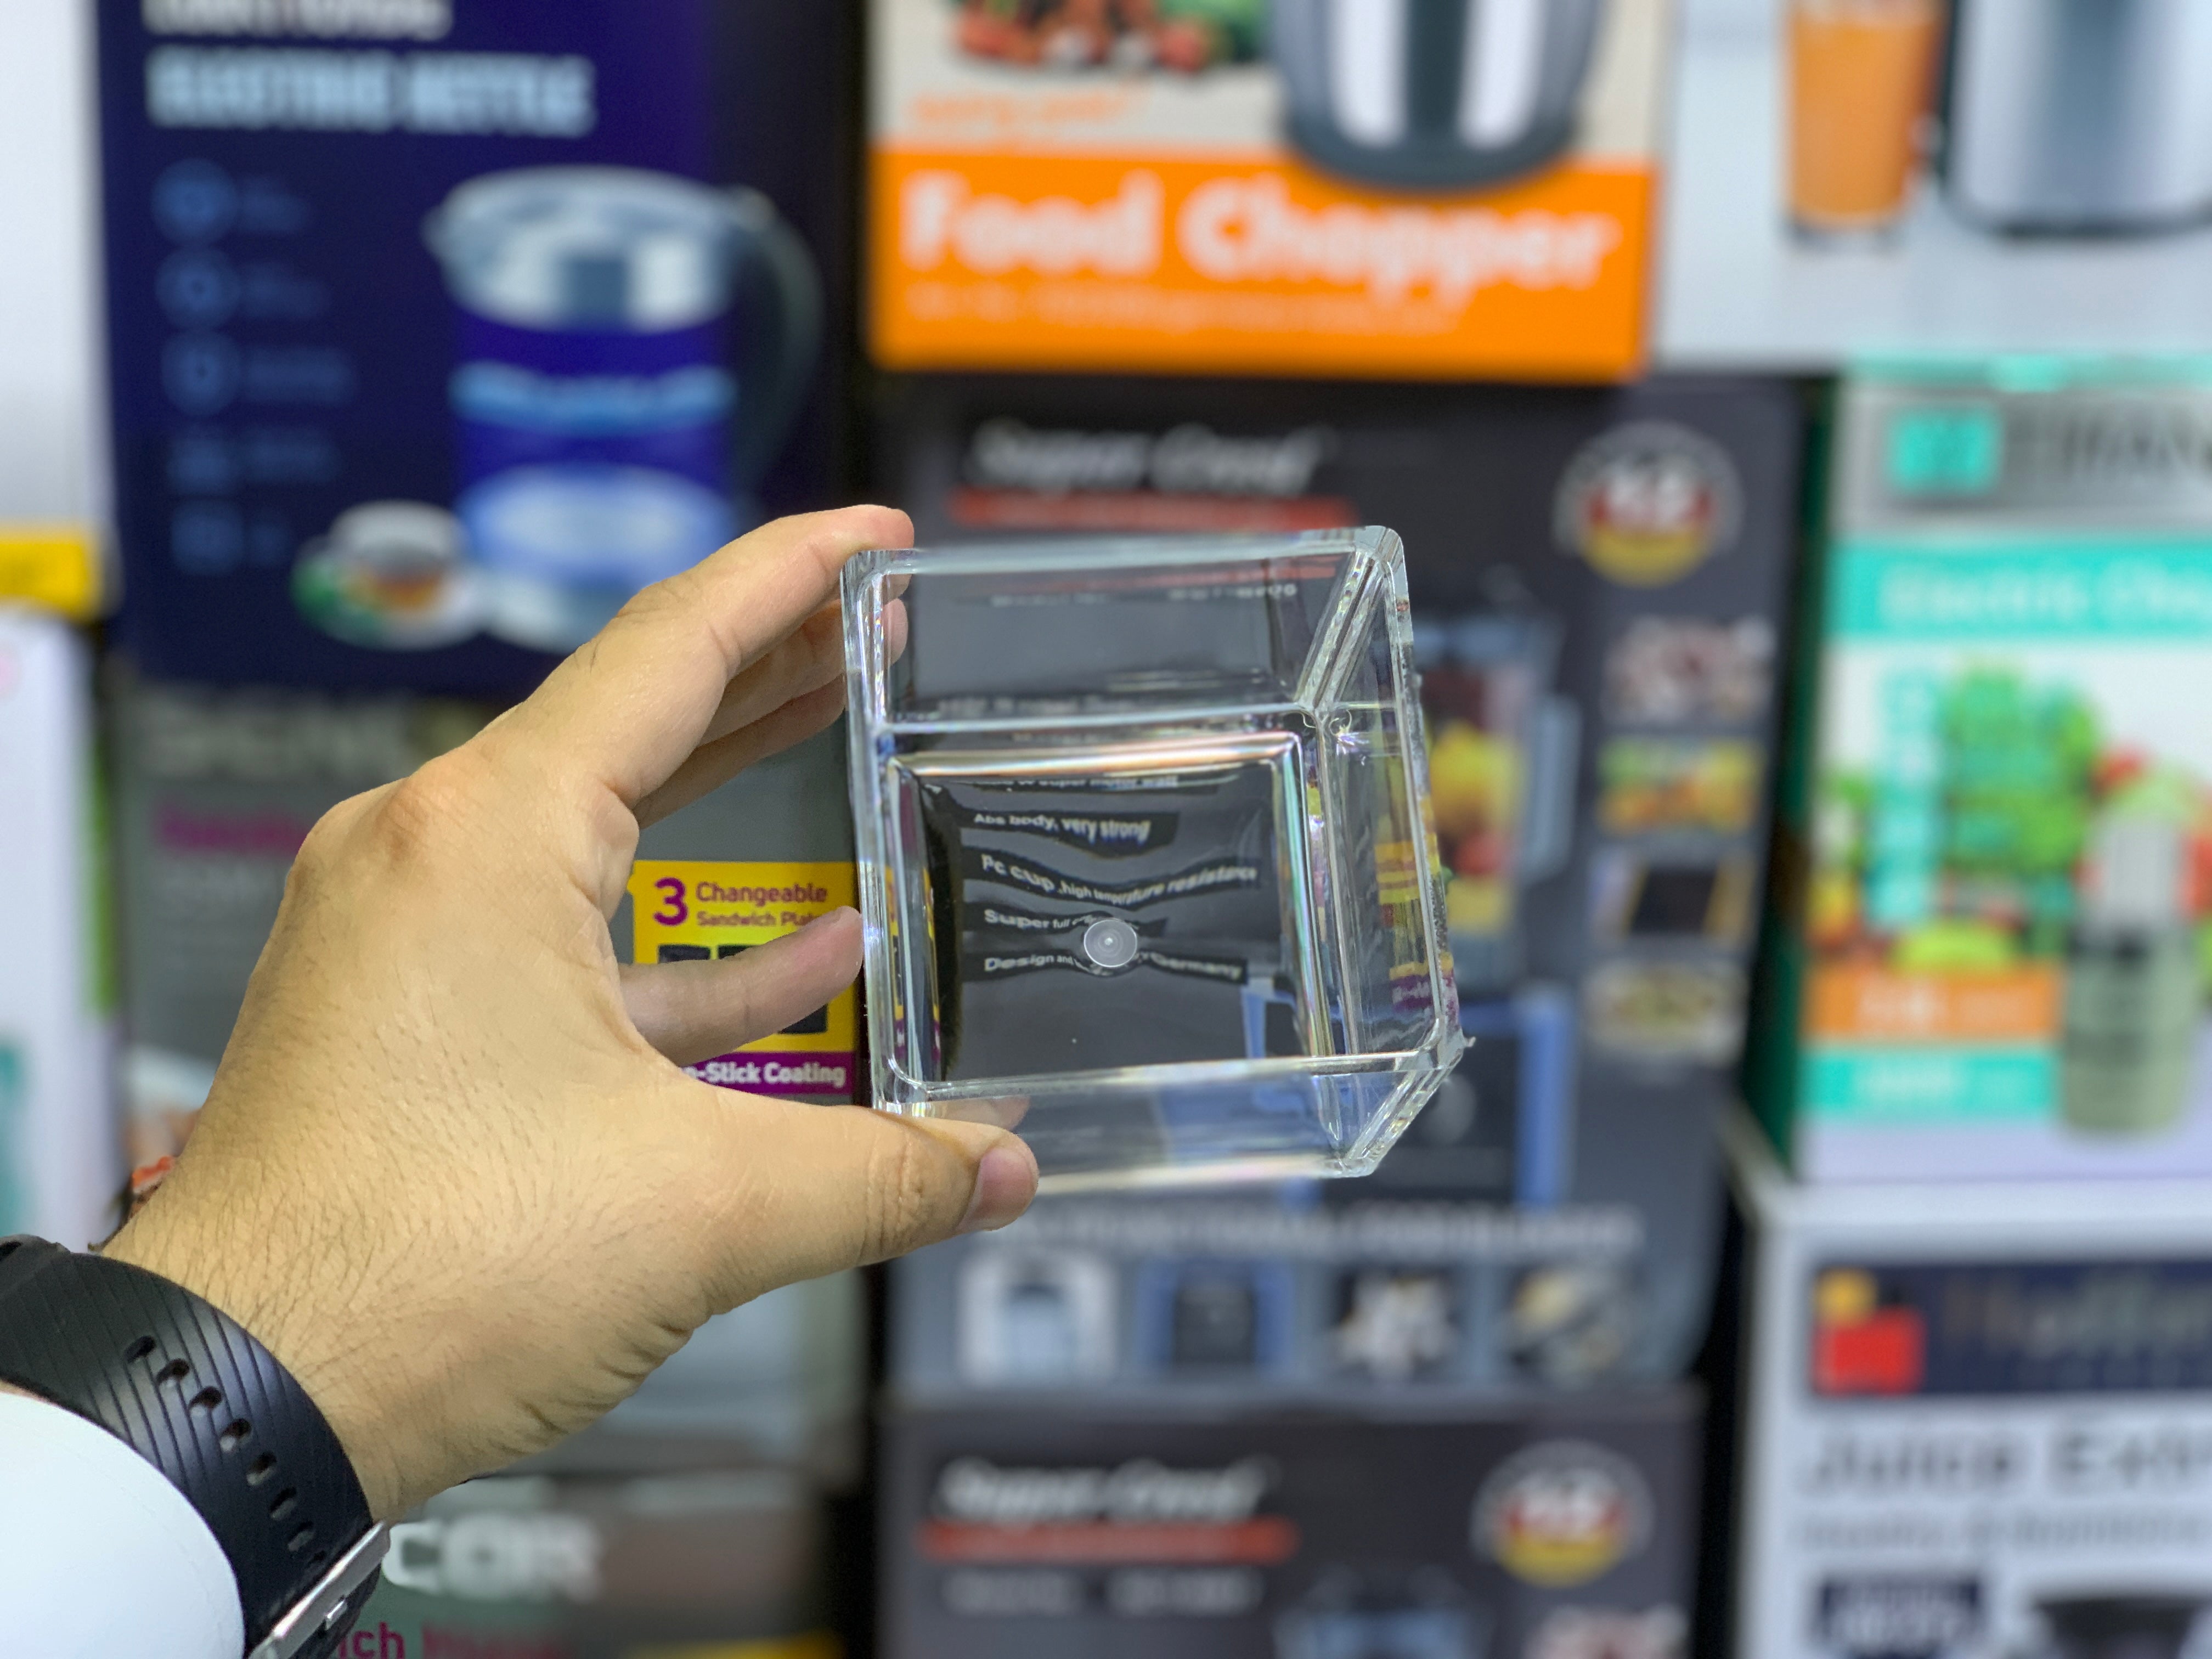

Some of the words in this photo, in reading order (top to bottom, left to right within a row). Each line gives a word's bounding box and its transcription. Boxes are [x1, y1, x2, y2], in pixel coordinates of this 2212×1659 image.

[901, 170, 1162, 274] Food
[1177, 172, 1623, 308] Chopper
[1060, 816, 1097, 845] very
[1099, 819, 1152, 847] strong
[653, 877, 689, 927] 3
[695, 880, 828, 907] Changeable
[695, 910, 777, 927] Sandwich
[984, 908, 1050, 930] Super
[984, 953, 1054, 974] Design
[684, 1061, 762, 1086] n-Stick
[764, 1061, 847, 1090] Coating
[384, 1514, 608, 1601] COR
